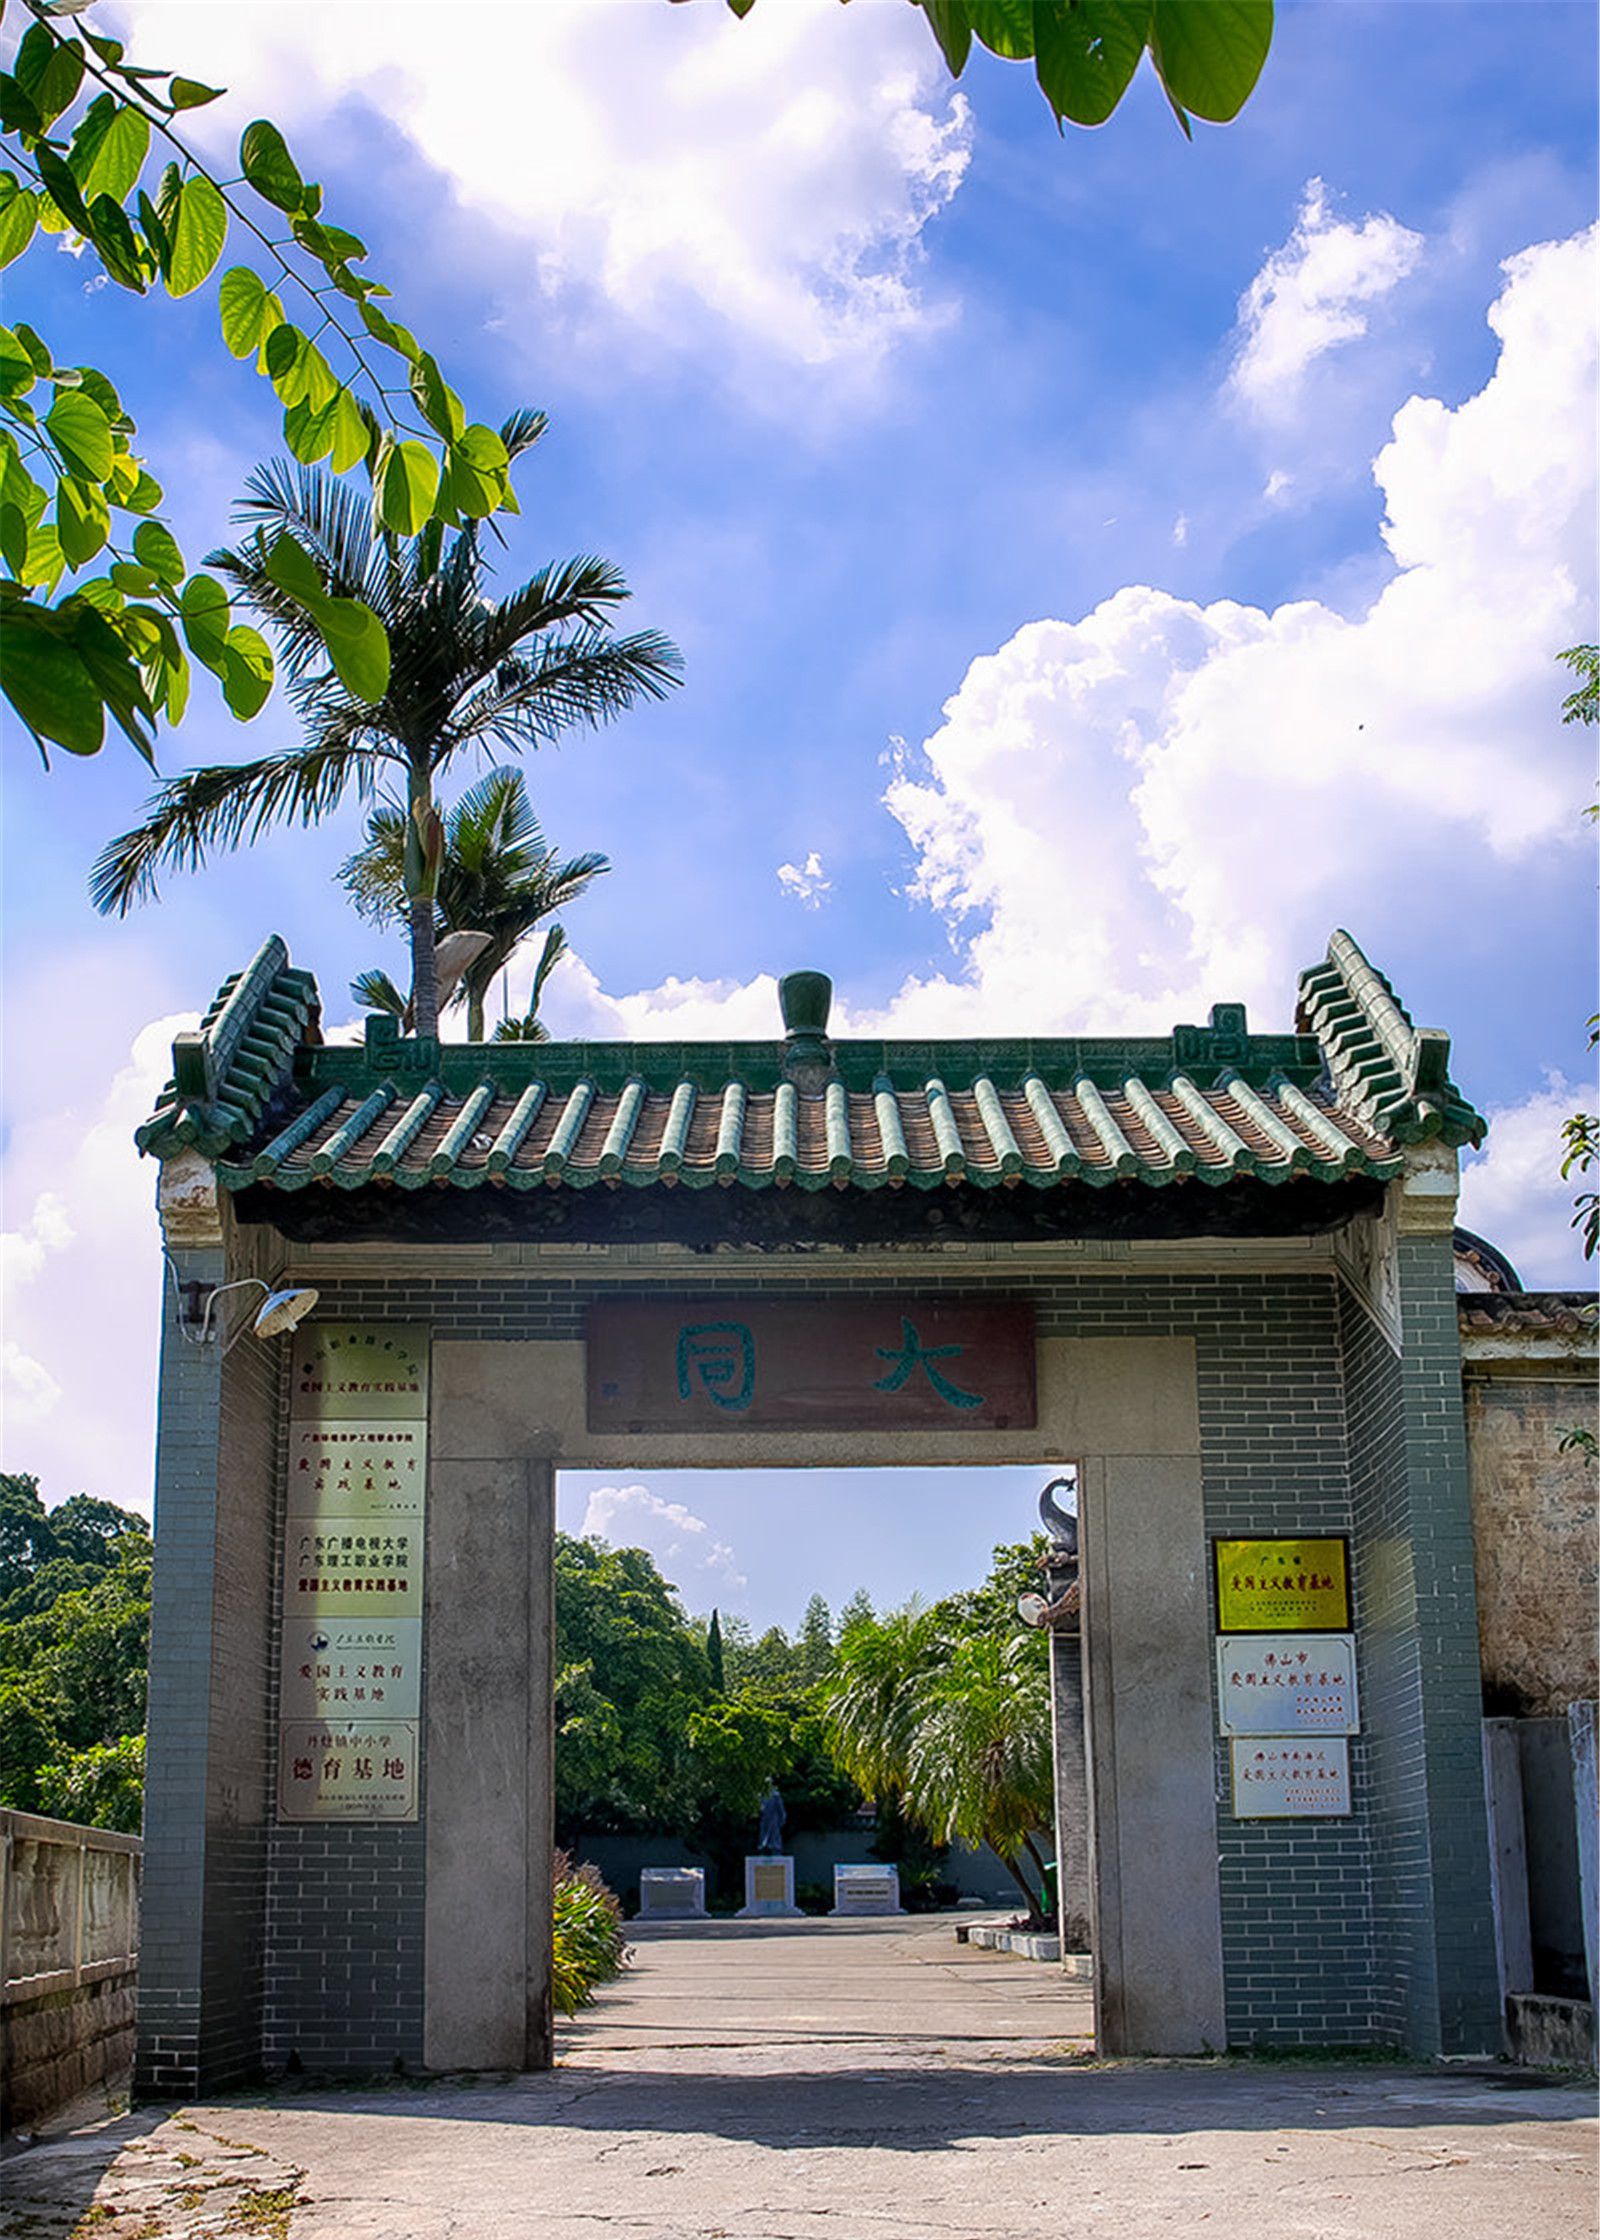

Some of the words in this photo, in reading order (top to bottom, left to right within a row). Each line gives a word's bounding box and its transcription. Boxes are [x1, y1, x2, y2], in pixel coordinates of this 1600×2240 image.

[299, 1458, 415, 1472] 爱国主义教育
[300, 1536, 408, 1550] 广东广播电视大学
[299, 1553, 408, 1568] 广东理工职业学院
[298, 1578, 408, 1592] 爱国主义教育实践基地
[1264, 1651, 1308, 1668] 佛山市
[299, 1664, 403, 1678] 爱国主义教育
[316, 1686, 385, 1701] 实践基地
[293, 1757, 405, 1780] 德育基地
